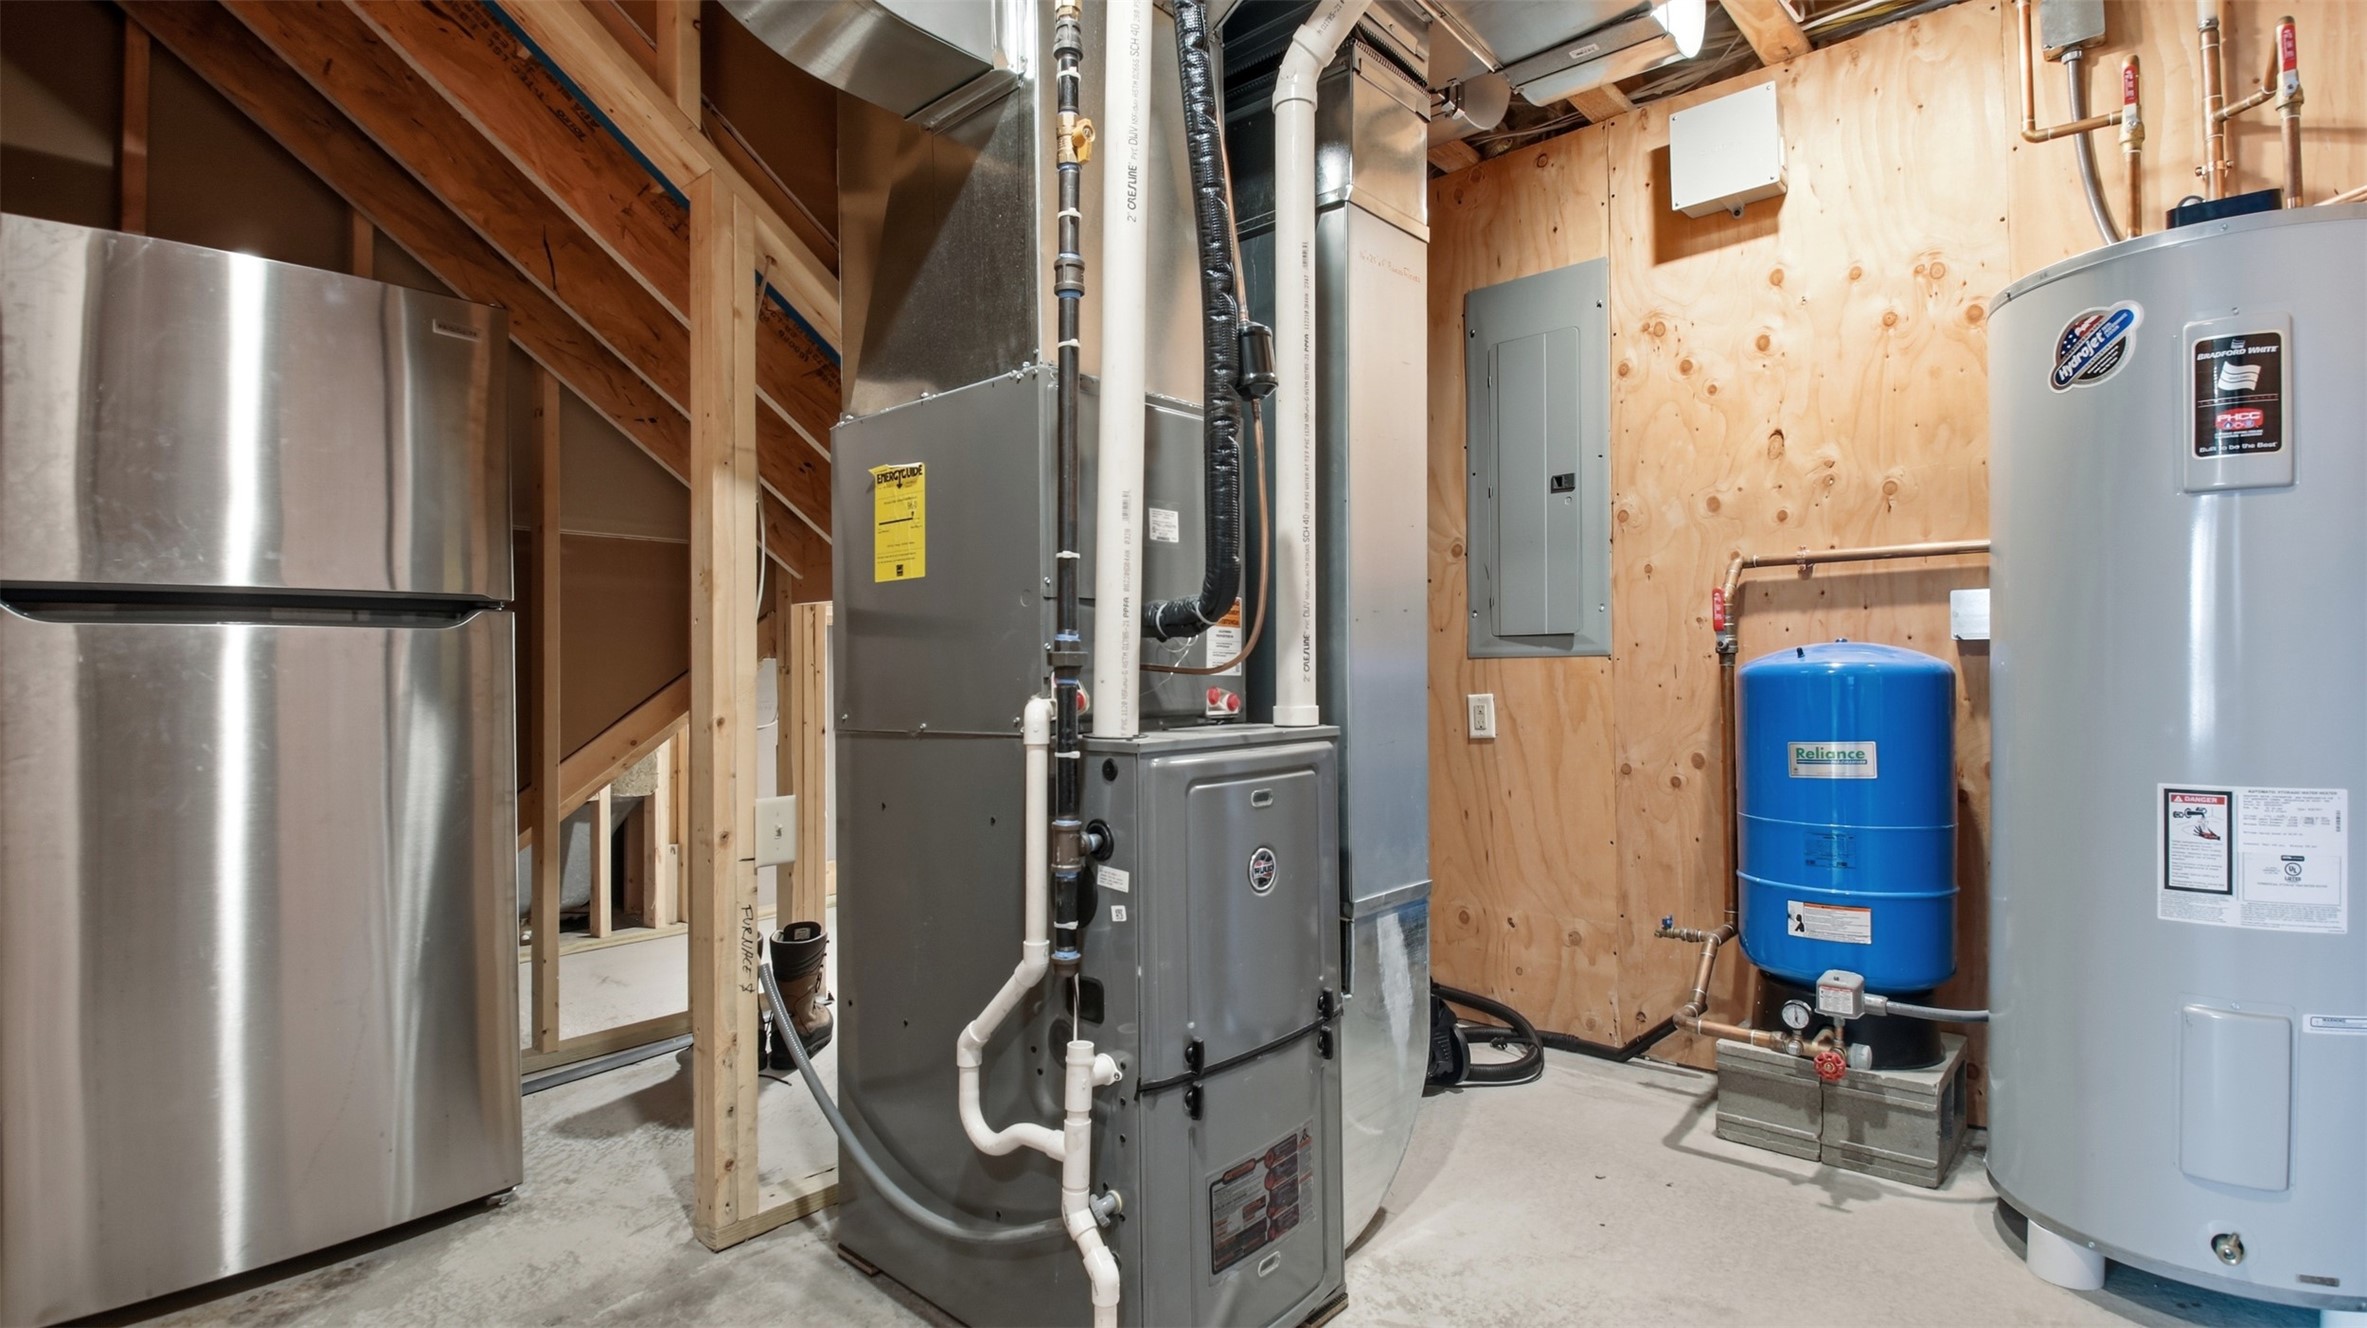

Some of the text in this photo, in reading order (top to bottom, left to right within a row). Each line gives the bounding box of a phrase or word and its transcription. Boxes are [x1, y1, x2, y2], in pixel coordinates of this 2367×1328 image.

[1130, 24, 1140, 37] 40
[1130, 38, 1140, 57] SCH
[2197, 345, 2279, 361] BRADFORD WHITE
[2216, 411, 2262, 422] PHCC
[1795, 746, 1866, 760] Reliance
[2184, 795, 2218, 804] DANGER
[741, 904, 754, 979] FURNACE
